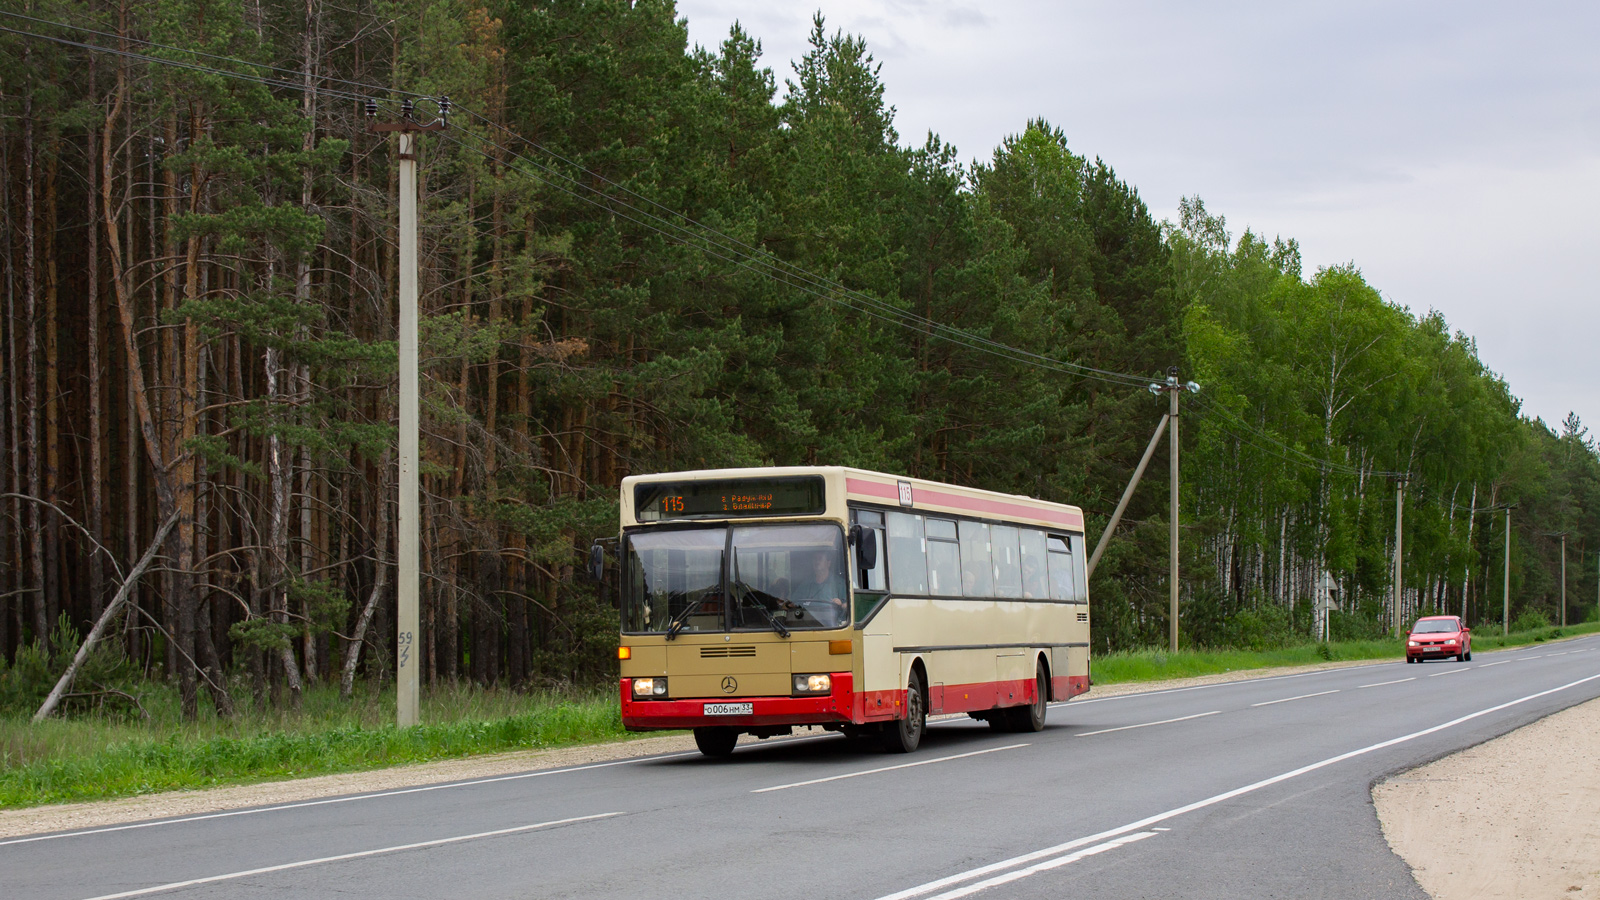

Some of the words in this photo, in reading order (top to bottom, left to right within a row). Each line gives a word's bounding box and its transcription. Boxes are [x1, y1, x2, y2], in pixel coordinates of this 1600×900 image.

[900, 486, 910, 501] 115
[662, 496, 685, 512] 115
[398, 631, 412, 644] 59
[741, 703, 750, 711] 33
